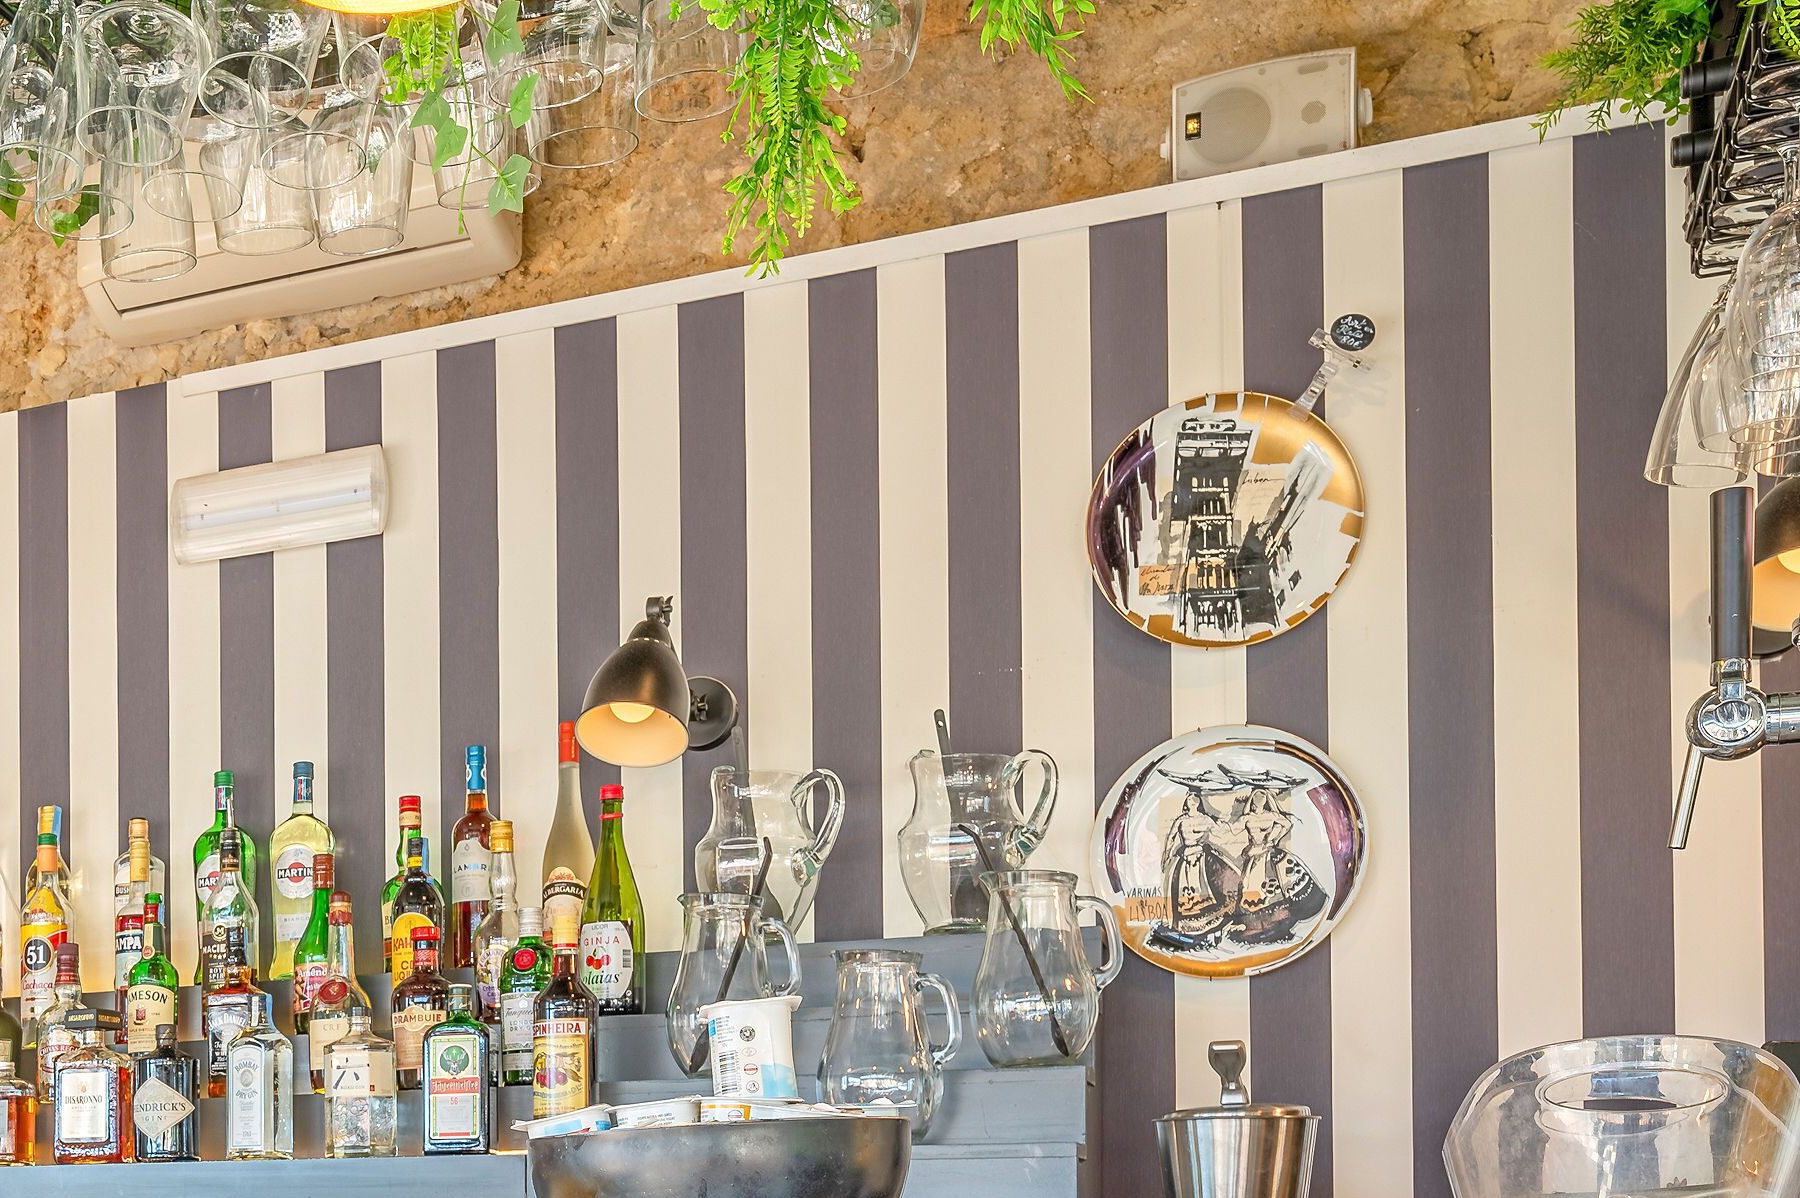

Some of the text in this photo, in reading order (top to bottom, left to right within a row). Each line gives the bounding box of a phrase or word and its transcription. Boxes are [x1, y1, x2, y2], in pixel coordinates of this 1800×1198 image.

[278, 868, 313, 879] MARTIN
[1129, 903, 1169, 922] LISBOA
[116, 936, 143, 950] AMPA
[393, 938, 413, 951] KAH
[584, 937, 621, 946] GINJA
[25, 945, 47, 965] 51
[22, 979, 54, 993] Cachaça
[393, 1013, 442, 1025] DRAMBUIE
[533, 1021, 581, 1037] SPINHEIRA
[60, 1044, 79, 1052] REGA
[234, 1061, 259, 1073] BOMBAY
[64, 1095, 103, 1106] DISARONNO
[134, 1101, 187, 1113] ENDRICK'S
